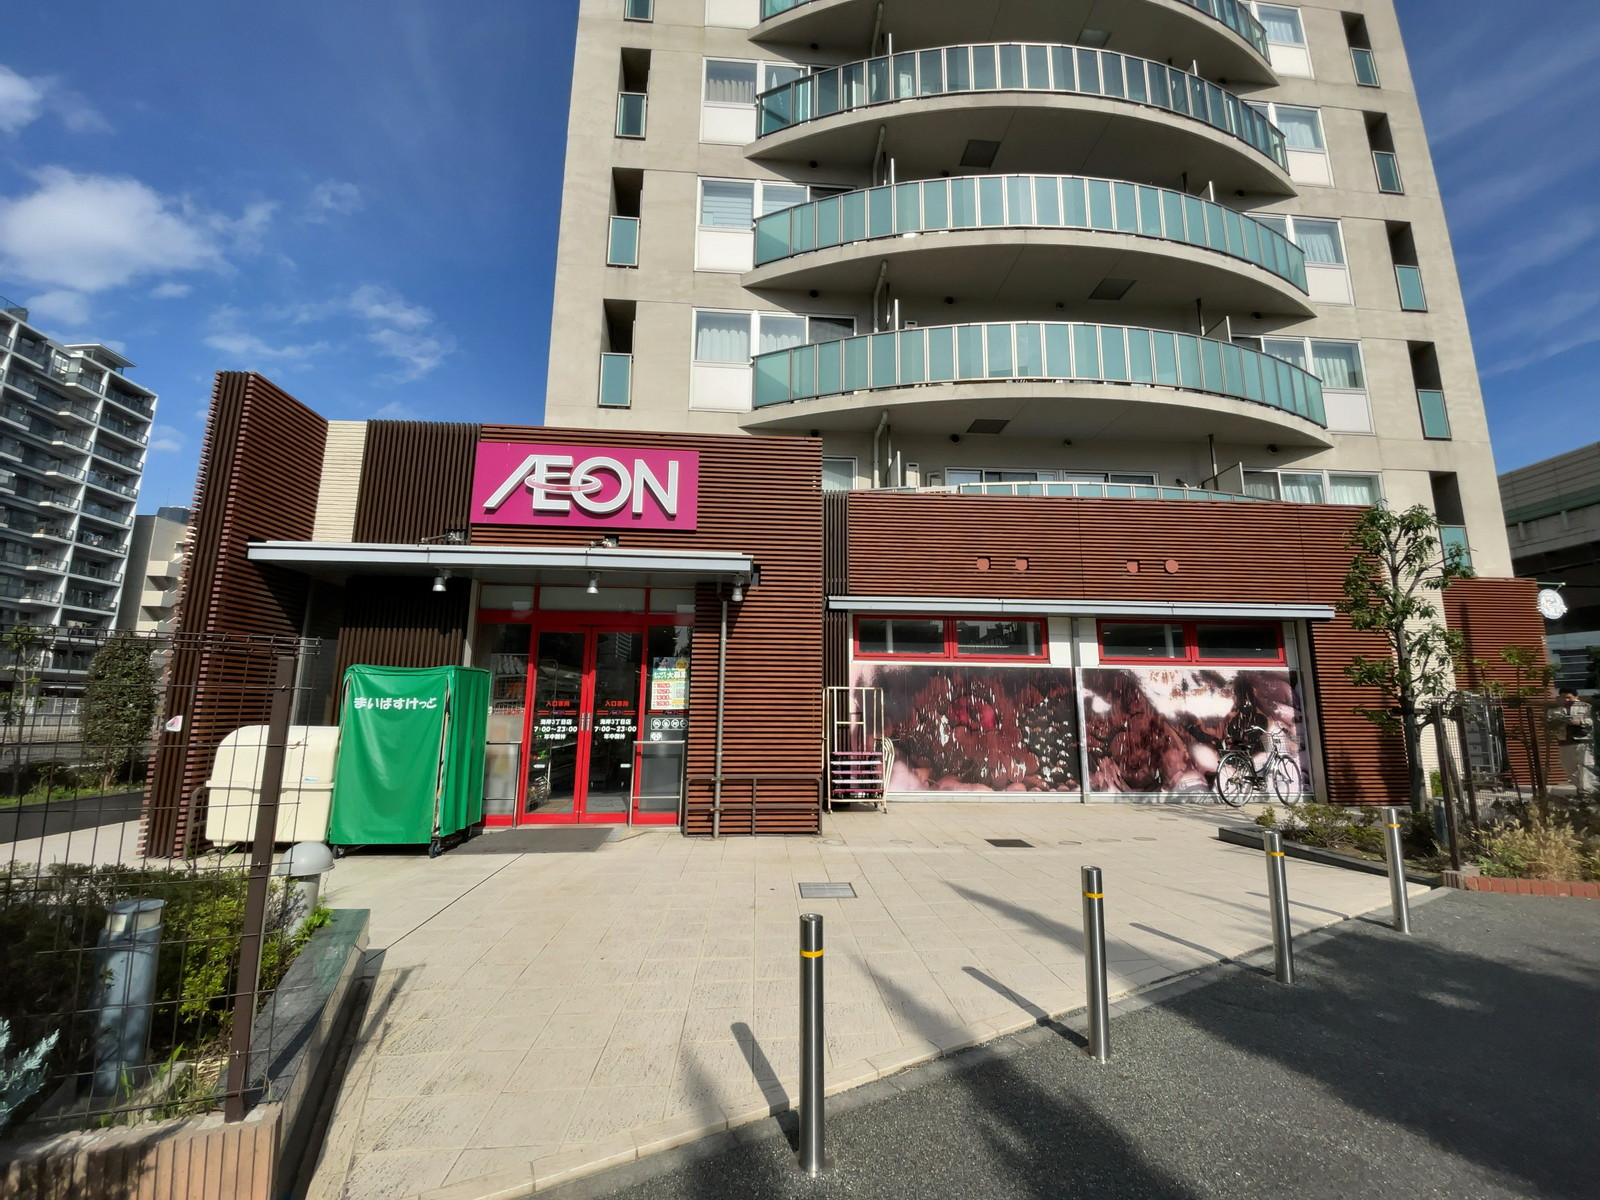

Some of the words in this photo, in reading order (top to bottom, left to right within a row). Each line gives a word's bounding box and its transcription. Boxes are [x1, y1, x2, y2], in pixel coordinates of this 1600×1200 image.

[353, 697, 437, 710] まいばすけっと
